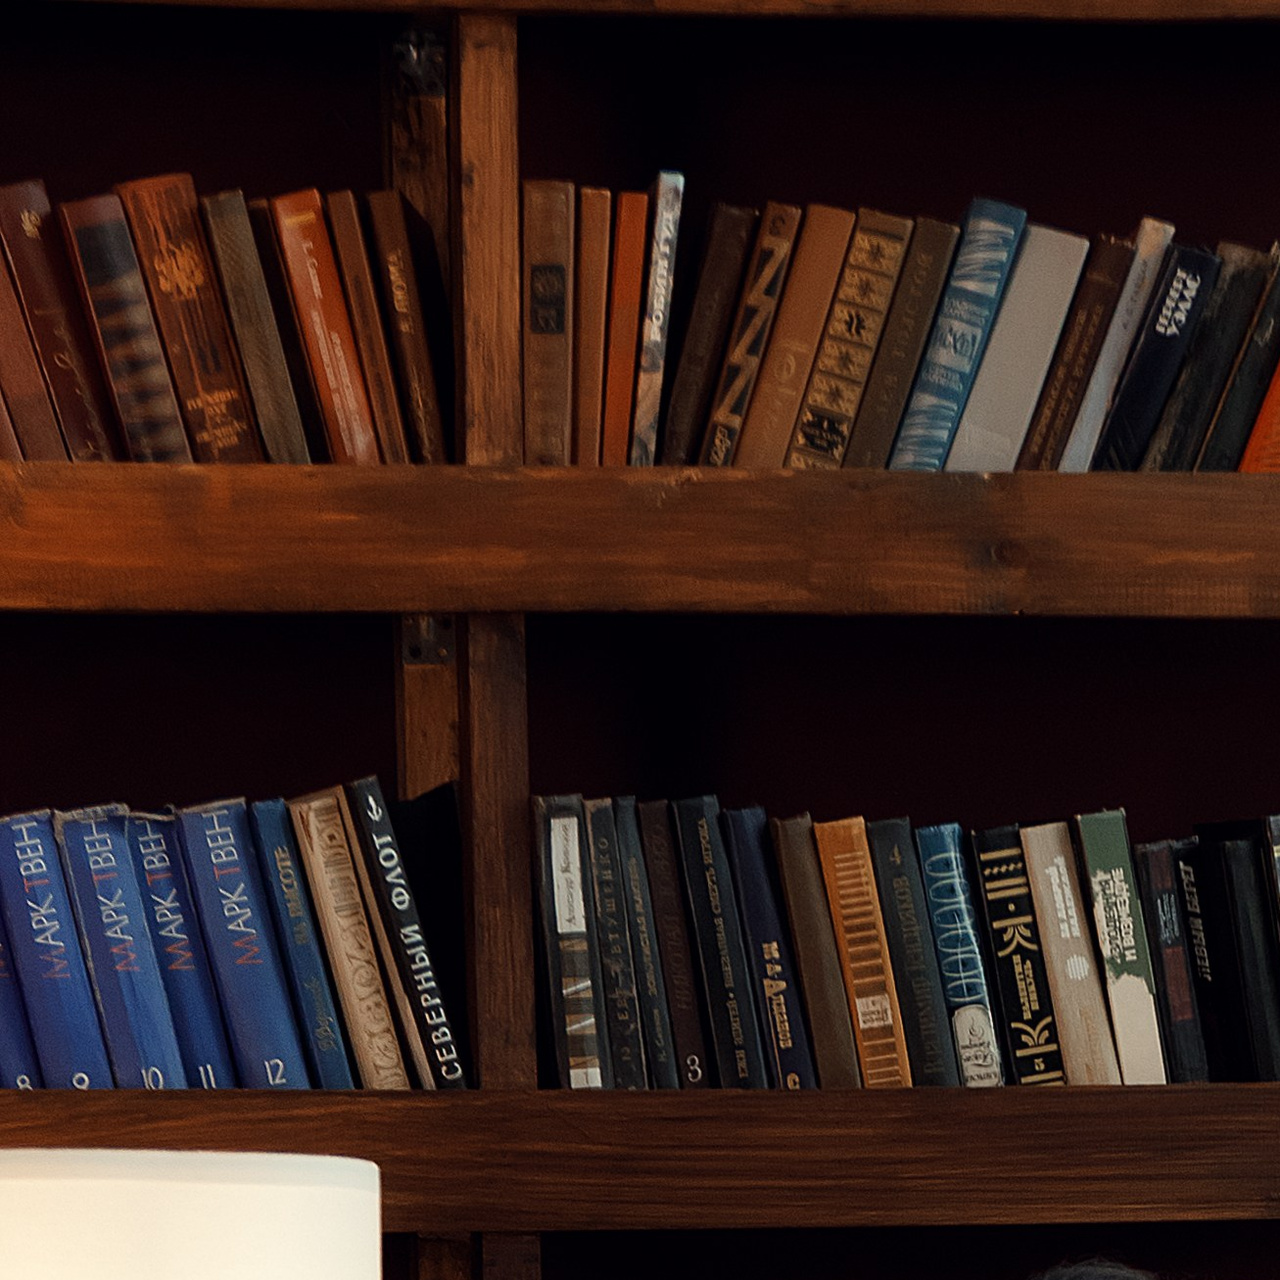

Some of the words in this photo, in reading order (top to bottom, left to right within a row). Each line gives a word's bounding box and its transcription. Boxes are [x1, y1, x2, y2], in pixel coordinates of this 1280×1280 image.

[655, 205, 676, 254] ГУД
[644, 258, 668, 344] РОБИН
[11, 820, 52, 893] ТВЕН
[84, 812, 118, 885] ТВЕН
[136, 818, 172, 887] ТВЕН
[205, 807, 241, 881] ТВЕН
[373, 834, 411, 911] ФЛОТ
[273, 846, 305, 918] ВЫСОТЕ
[708, 866, 725, 913] СМЕРТЬ
[1180, 860, 1203, 917] БЕРЕГ
[27, 894, 71, 979] МАРК
[96, 887, 140, 971] МАРК
[150, 889, 195, 971] МАРК
[219, 882, 264, 965] МАРК
[892, 875, 922, 973] ТЕНДРЯКОВ
[1189, 921, 1213, 982] ЛЕВЫЙ
[400, 923, 463, 1081] СЕВЕРНЫЙ
[1012, 954, 1030, 1020] ВАЛЕНТИН
[1024, 959, 1040, 1011] ПИКУЛЬ
[140, 1066, 164, 1090] 10
[198, 1065, 216, 1089] 11
[263, 1059, 287, 1085] 12
[685, 1053, 703, 1084] 3
